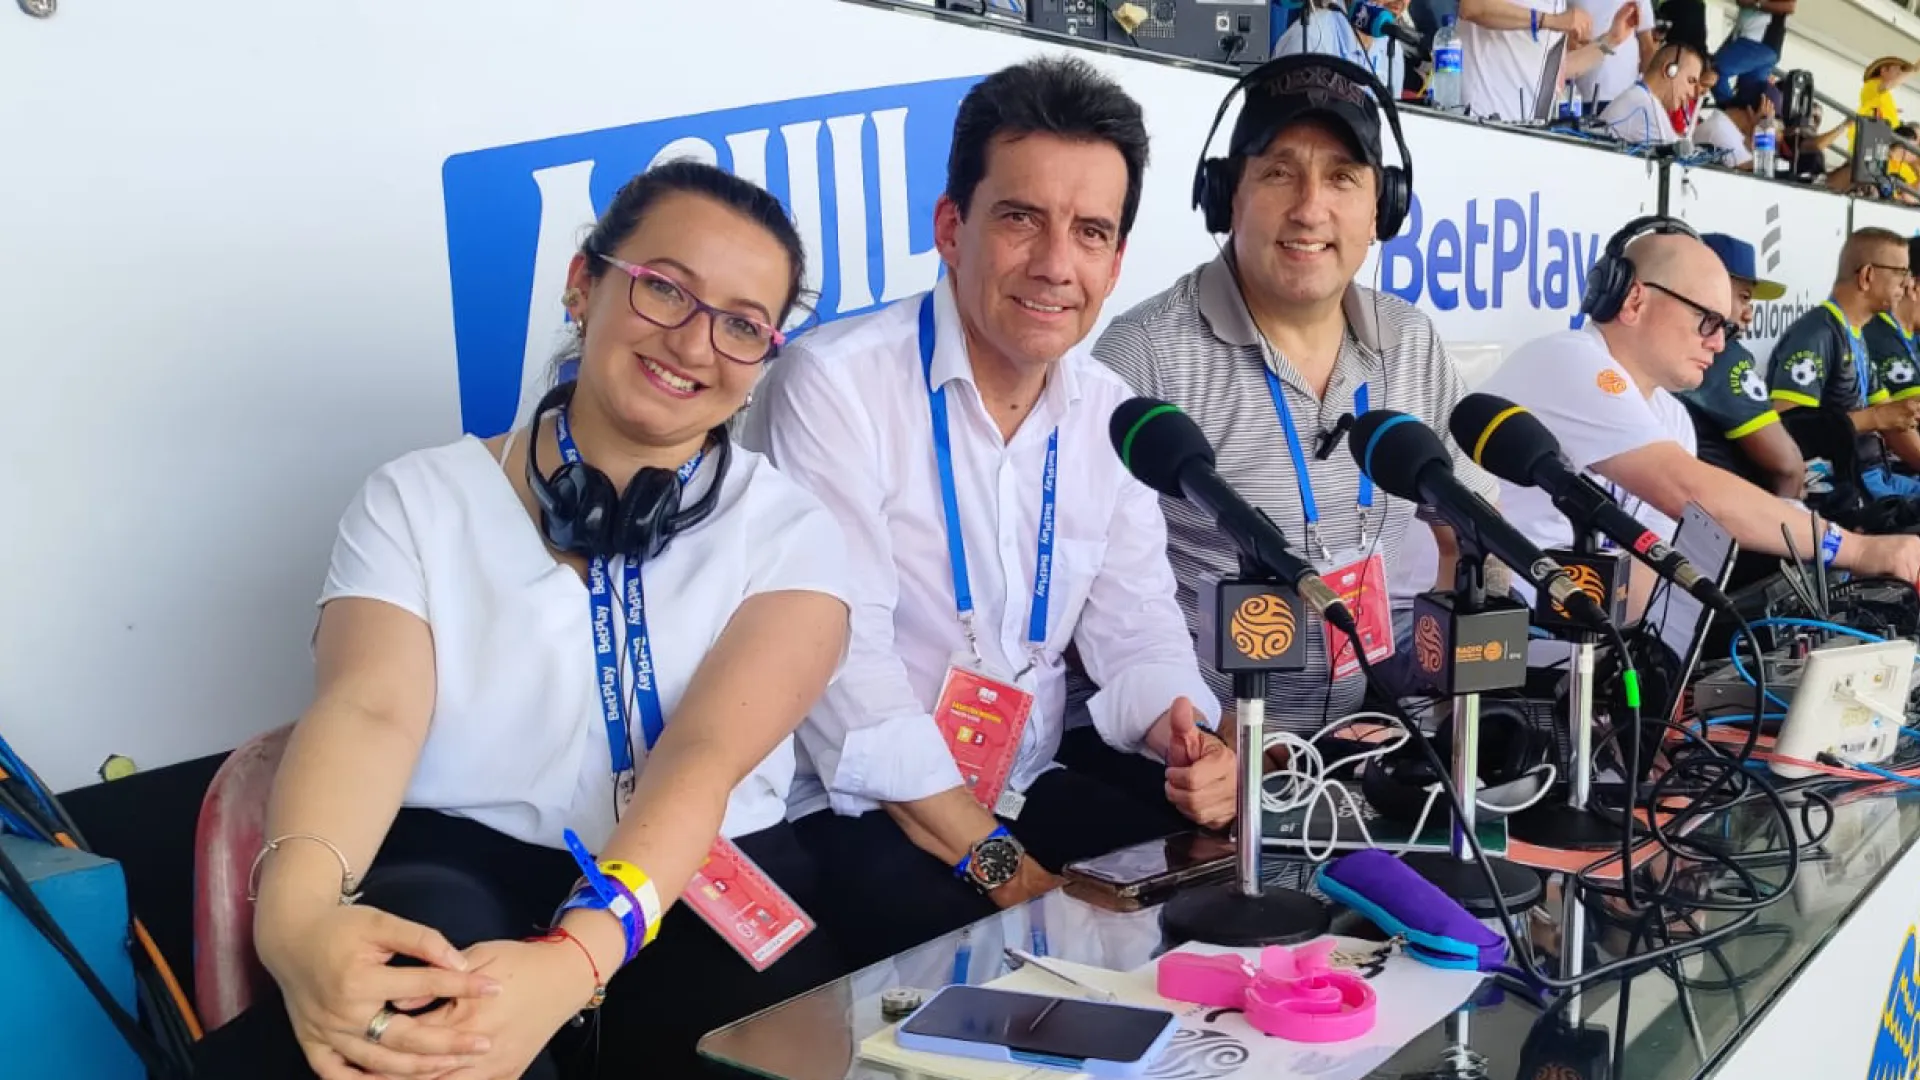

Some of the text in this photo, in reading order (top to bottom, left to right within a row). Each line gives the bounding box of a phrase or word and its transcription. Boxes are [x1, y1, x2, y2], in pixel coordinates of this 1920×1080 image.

[1380, 191, 1599, 330] BetPlay
[1039, 503, 1053, 544] BetPlay
[1035, 554, 1050, 597] BetPlay
[627, 578, 643, 626] BetPlay
[594, 605, 611, 654] BetPlay
[601, 666, 620, 722] BetPlay
